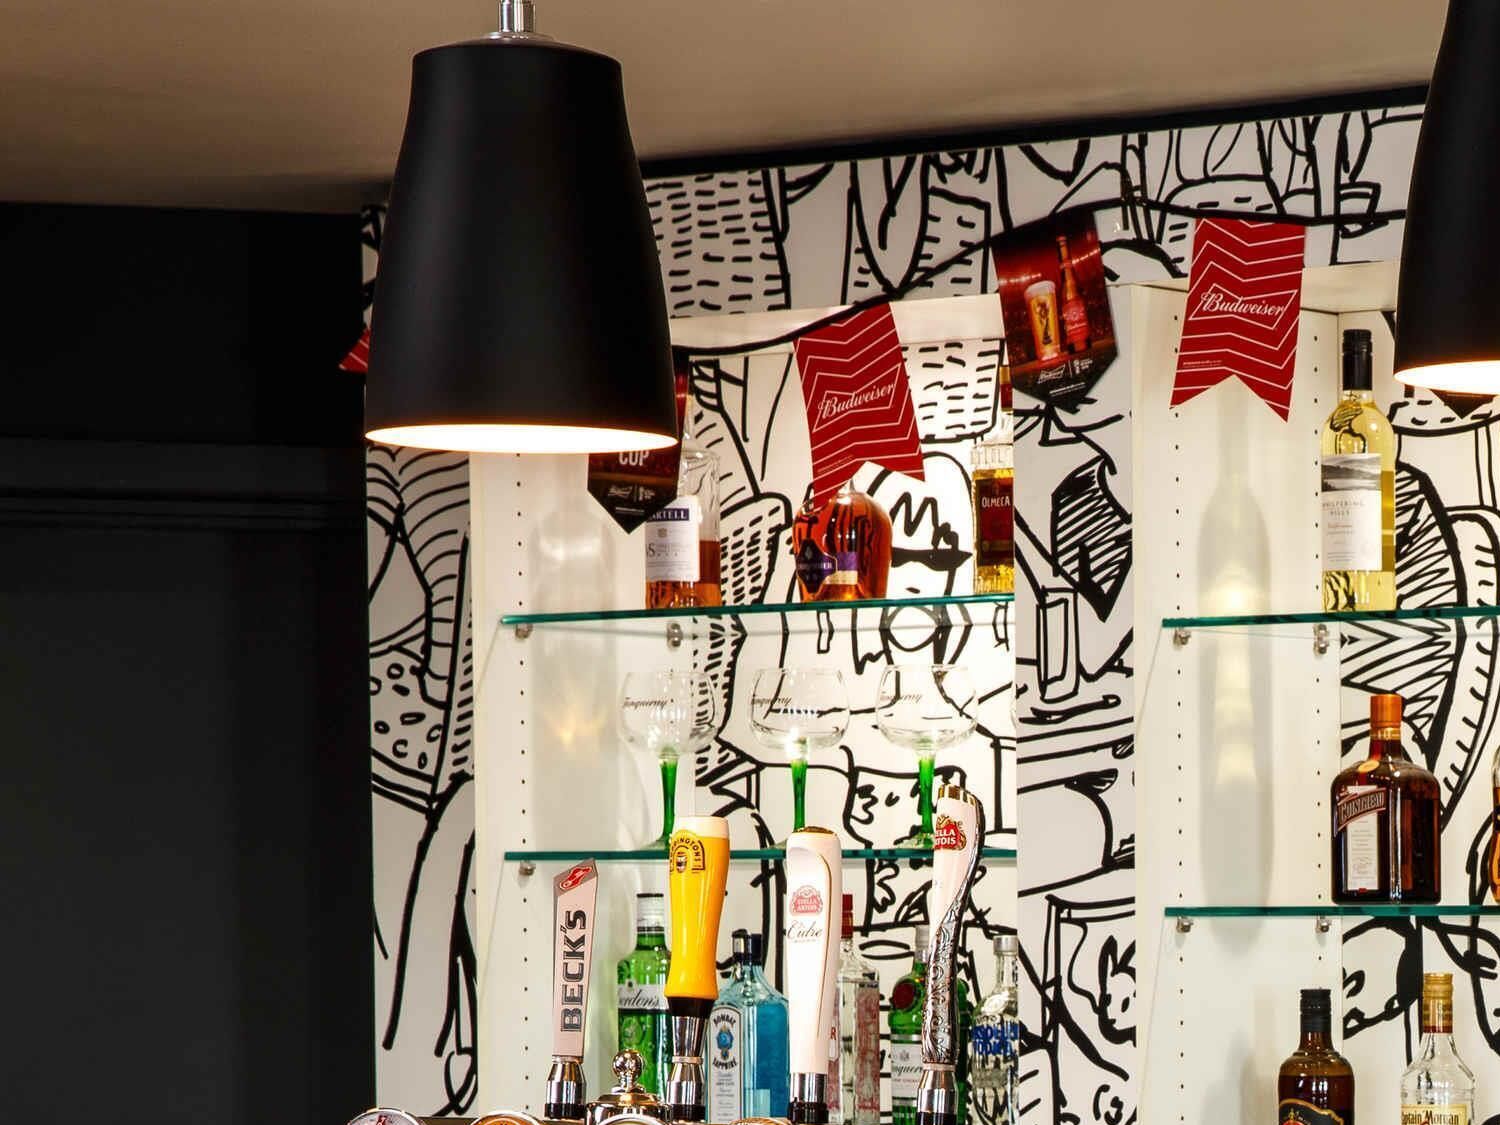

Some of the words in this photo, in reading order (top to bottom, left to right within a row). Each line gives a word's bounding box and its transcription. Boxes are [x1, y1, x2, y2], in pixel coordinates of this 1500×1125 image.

[1201, 291, 1285, 316] Budweiser
[818, 383, 895, 420] Budweiser
[981, 495, 1010, 508] OLMECA
[653, 510, 689, 520] ARTELL
[936, 829, 956, 837] ELLA
[936, 837, 957, 845] TOIS
[560, 909, 587, 1032] BECK'S
[713, 1014, 736, 1026] BOMBAY
[712, 1058, 737, 1070] SAPPHIRE
